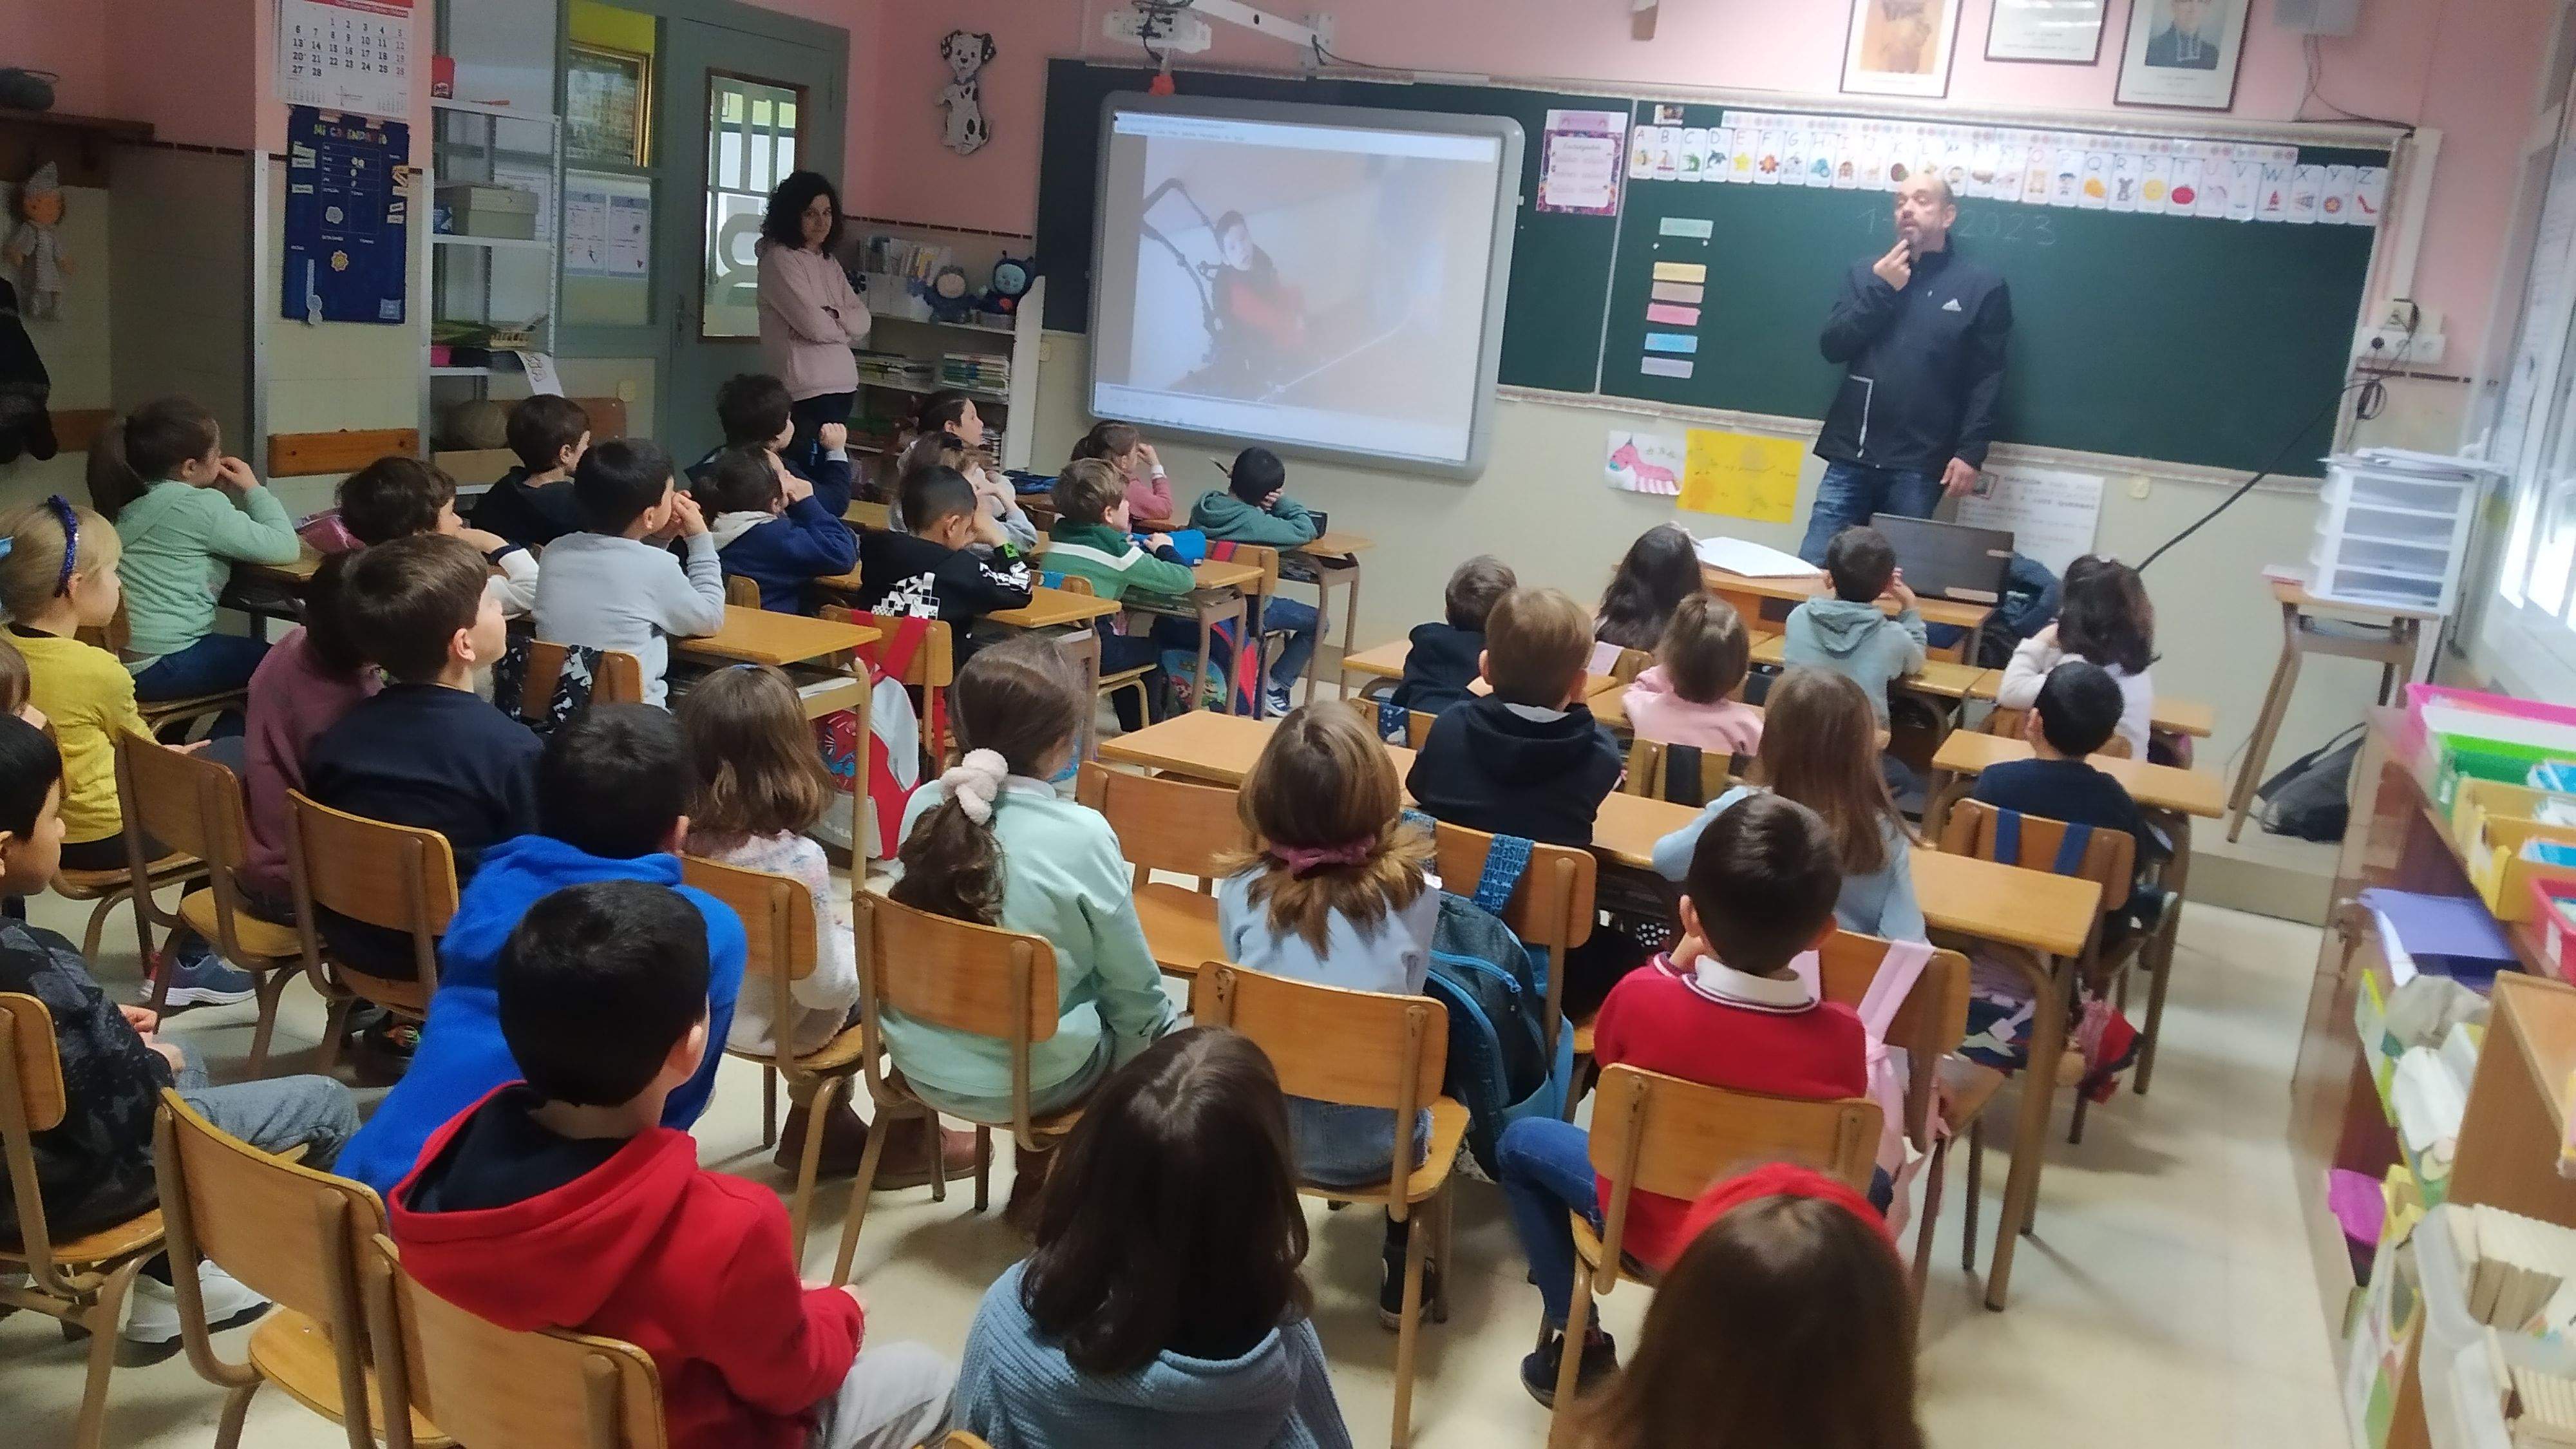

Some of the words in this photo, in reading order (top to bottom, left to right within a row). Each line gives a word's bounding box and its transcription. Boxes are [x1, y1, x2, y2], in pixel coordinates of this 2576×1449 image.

[346, 20, 350, 28] 2
[296, 25, 301, 33] 6
[346, 33, 351, 42] 9
[361, 36, 370, 44] 10
[378, 39, 386, 47] 11
[396, 41, 404, 50] 12
[293, 38, 303, 47] 13
[312, 41, 321, 50] 14
[329, 44, 337, 52] 15
[345, 46, 353, 55] 16
[379, 52, 388, 61] 18
[397, 54, 404, 62] 19
[292, 52, 304, 61] 20
[312, 54, 321, 63] 21
[329, 57, 338, 66] 22
[345, 59, 354, 68] 23
[361, 62, 371, 71] 24
[379, 64, 388, 73] 25
[397, 67, 404, 75] 26
[292, 65, 303, 74] 27
[312, 68, 321, 77] 28
[1636, 130, 1645, 140] A
[1660, 130, 1669, 143] B
[1685, 131, 1694, 144] C
[1710, 131, 1720, 144] D
[1736, 132, 1747, 145] E
[1762, 132, 1772, 146] F
[1788, 133, 1799, 146] G
[1814, 135, 1824, 148] H
[1841, 136, 1850, 149] I
[2031, 149, 2044, 162] O
[2087, 156, 2102, 171] Q
[2116, 156, 2126, 170] R
[2146, 158, 2156, 172] S
[2179, 160, 2190, 173] T
[2235, 164, 2246, 178] V
[2264, 167, 2284, 182] W
[2295, 167, 2310, 182] X
[2329, 167, 2342, 181] Y
[2358, 169, 2372, 184] Z
